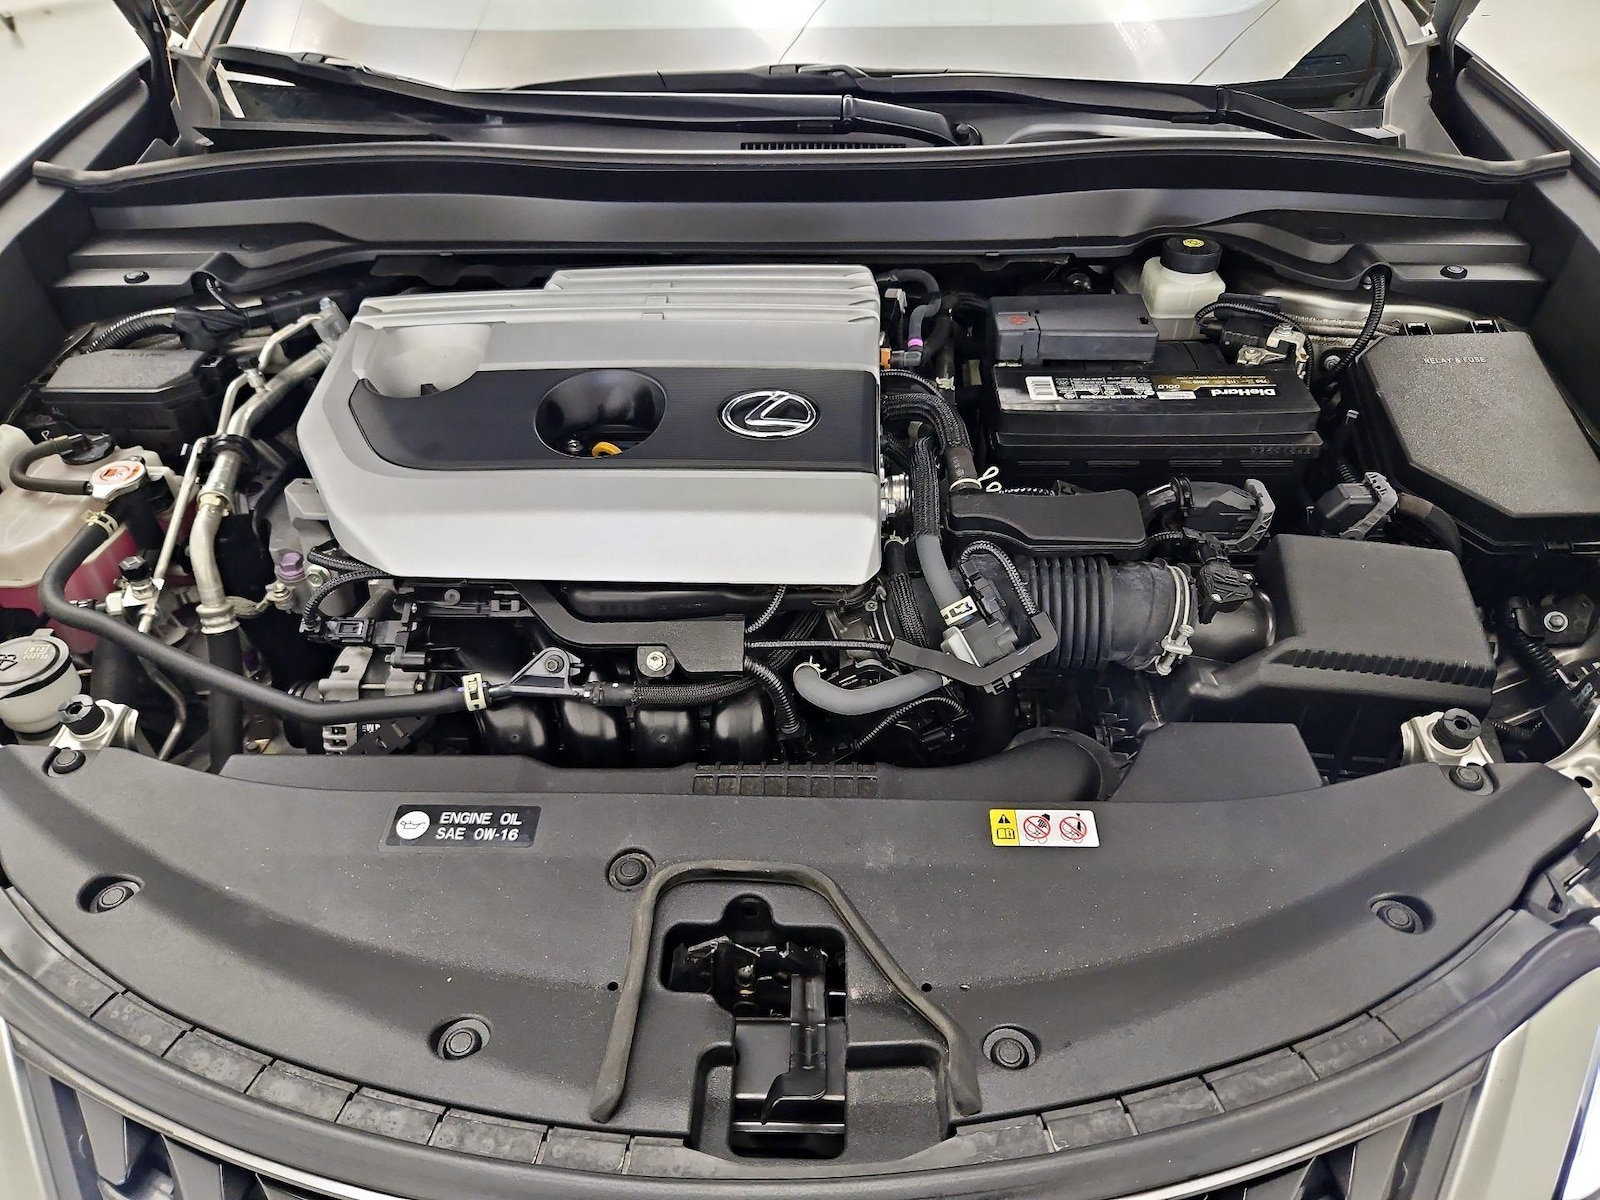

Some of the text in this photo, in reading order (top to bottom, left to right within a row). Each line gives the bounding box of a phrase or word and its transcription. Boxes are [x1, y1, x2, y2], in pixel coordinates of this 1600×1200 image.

[1422, 356, 1451, 364] RELAY
[1211, 388, 1276, 397] DieHard
[440, 812, 523, 826] ENGINE OIL
[435, 826, 520, 841] SAE 0W-16
